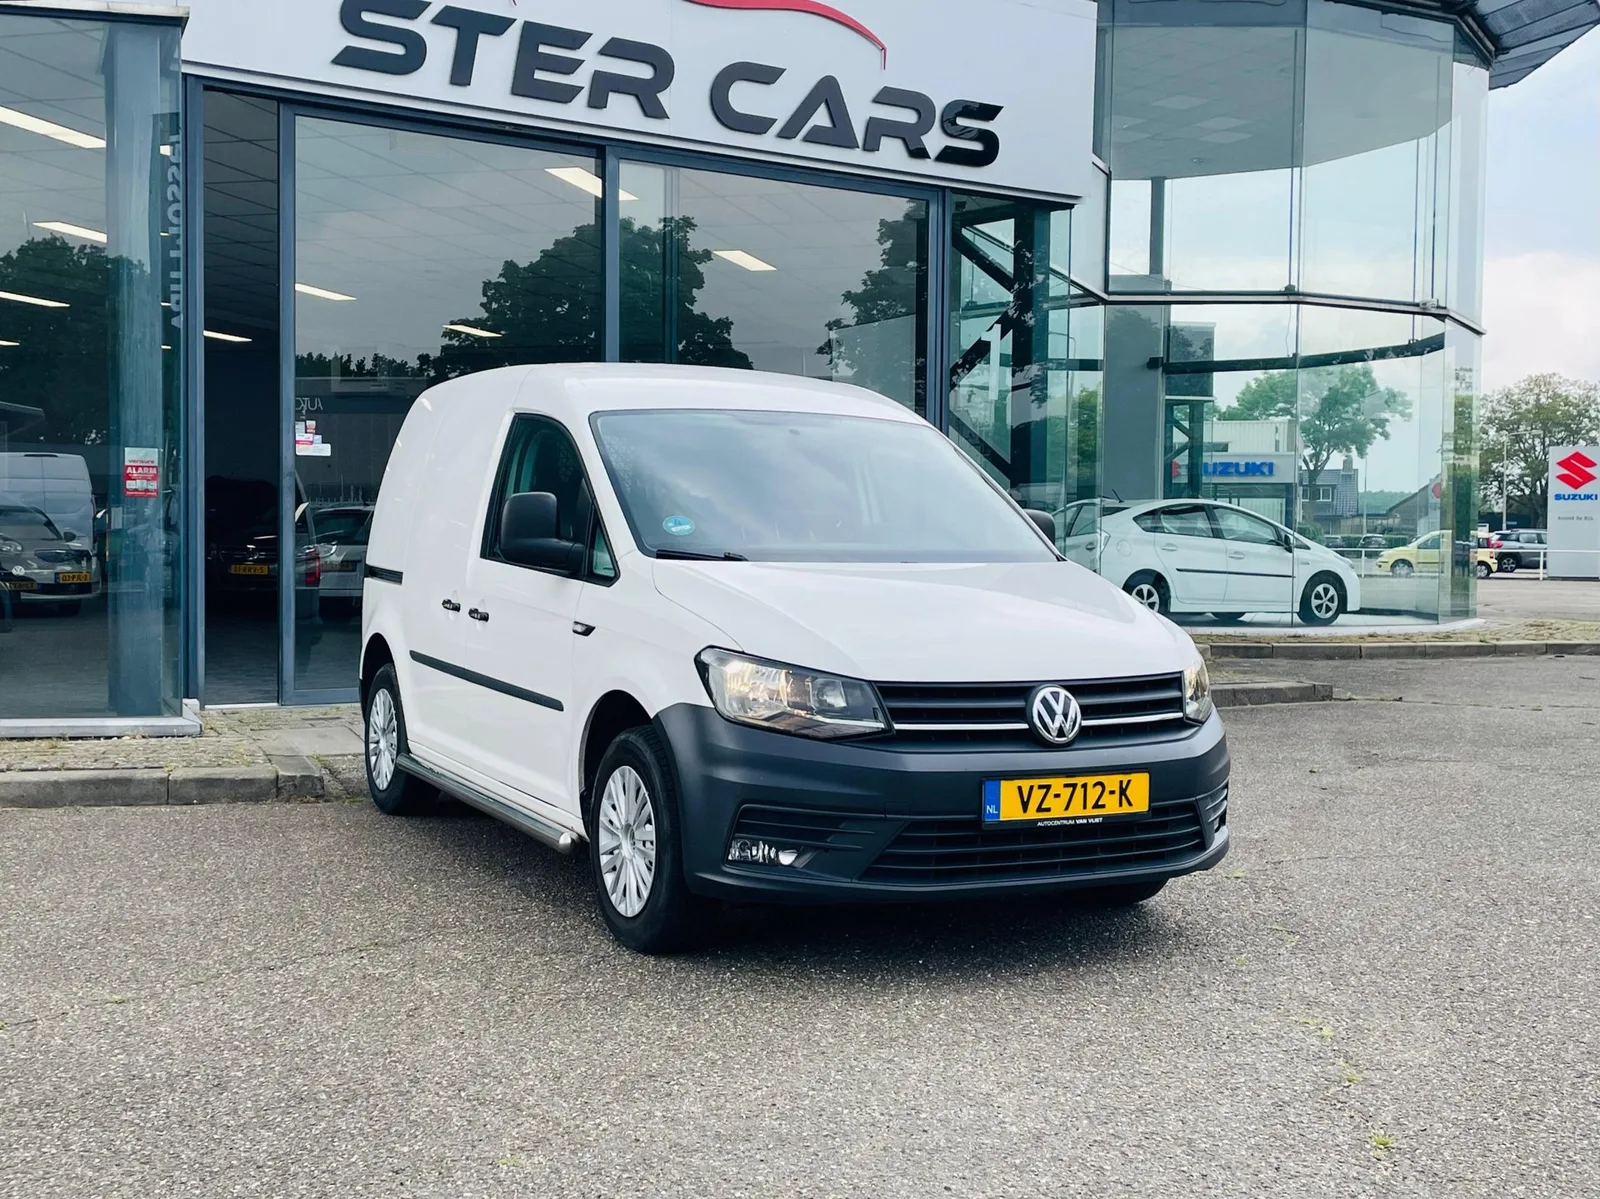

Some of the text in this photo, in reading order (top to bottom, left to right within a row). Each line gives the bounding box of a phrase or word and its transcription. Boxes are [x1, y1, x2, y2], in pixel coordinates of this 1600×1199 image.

[331, 0, 1004, 168] STER CARS
[126, 466, 157, 474] ALARM
[1202, 461, 1275, 477] UZUKI
[1554, 493, 1598, 501] SUZUKI
[986, 779, 1134, 814] NL VZ-712-K
[1037, 819, 1075, 827] AUTOCENTRUM
